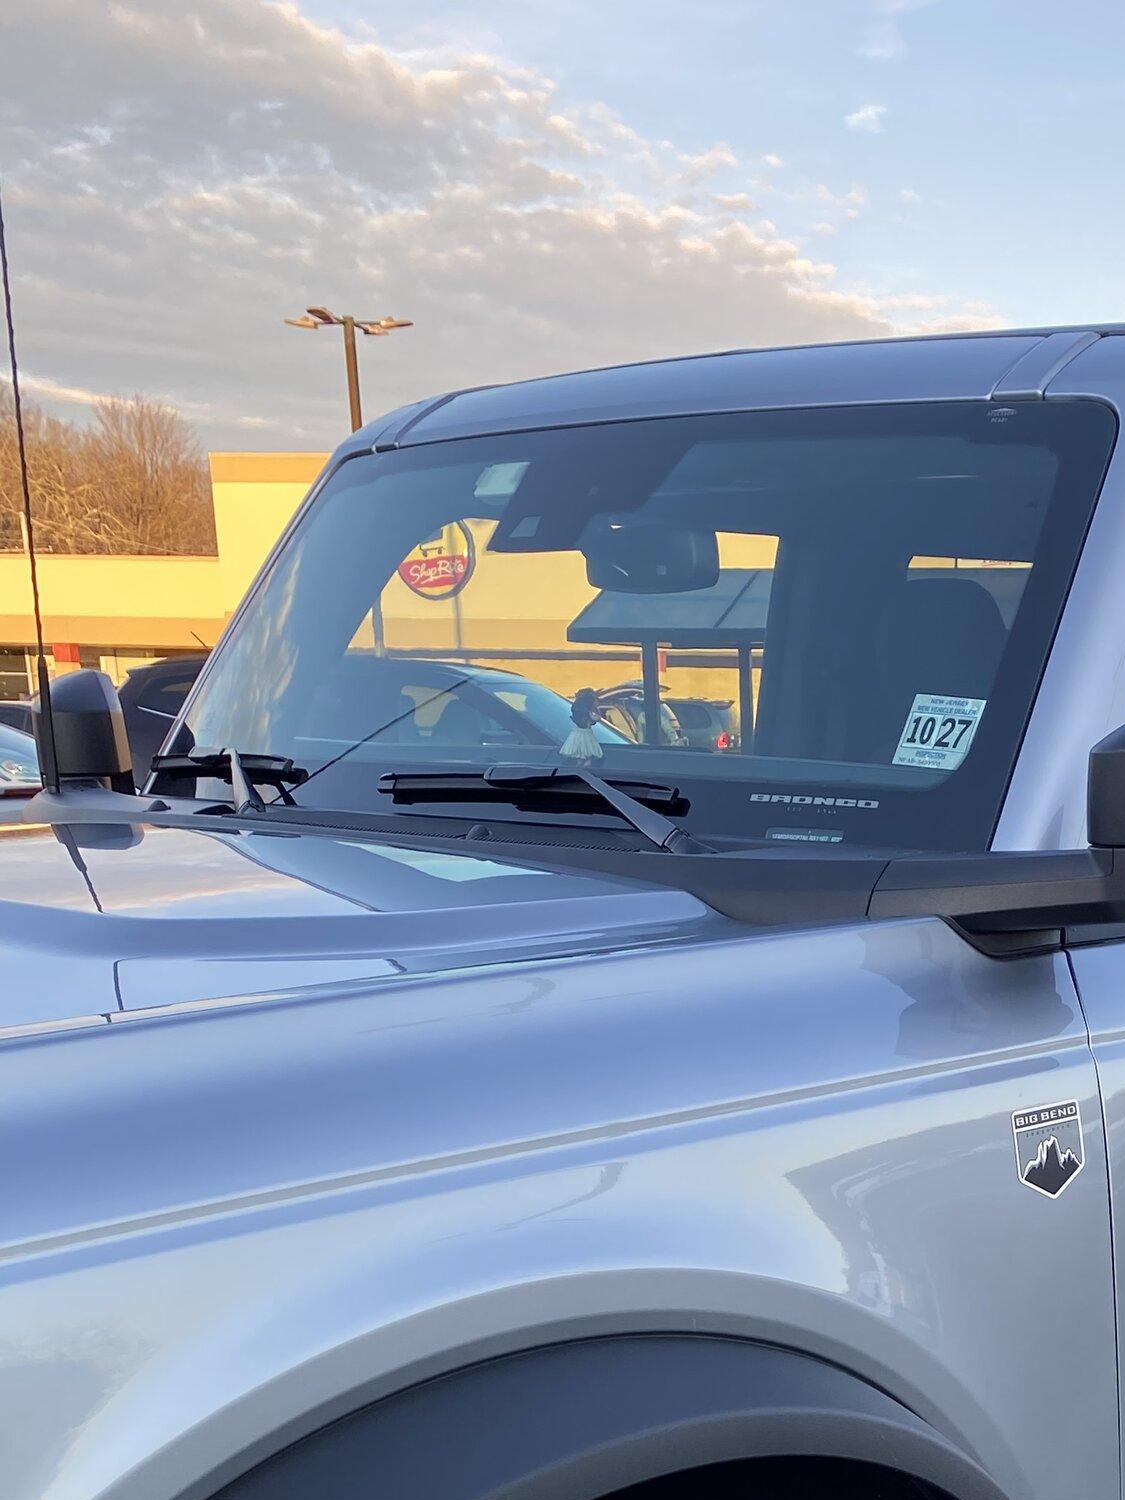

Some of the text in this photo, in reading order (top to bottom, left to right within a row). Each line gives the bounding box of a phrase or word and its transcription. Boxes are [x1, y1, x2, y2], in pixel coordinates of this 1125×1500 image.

[944, 699, 969, 707] JERSEY
[906, 716, 973, 749] 10 27
[750, 793, 880, 809] BRONCO
[1016, 1105, 1076, 1126] BIG BEND
